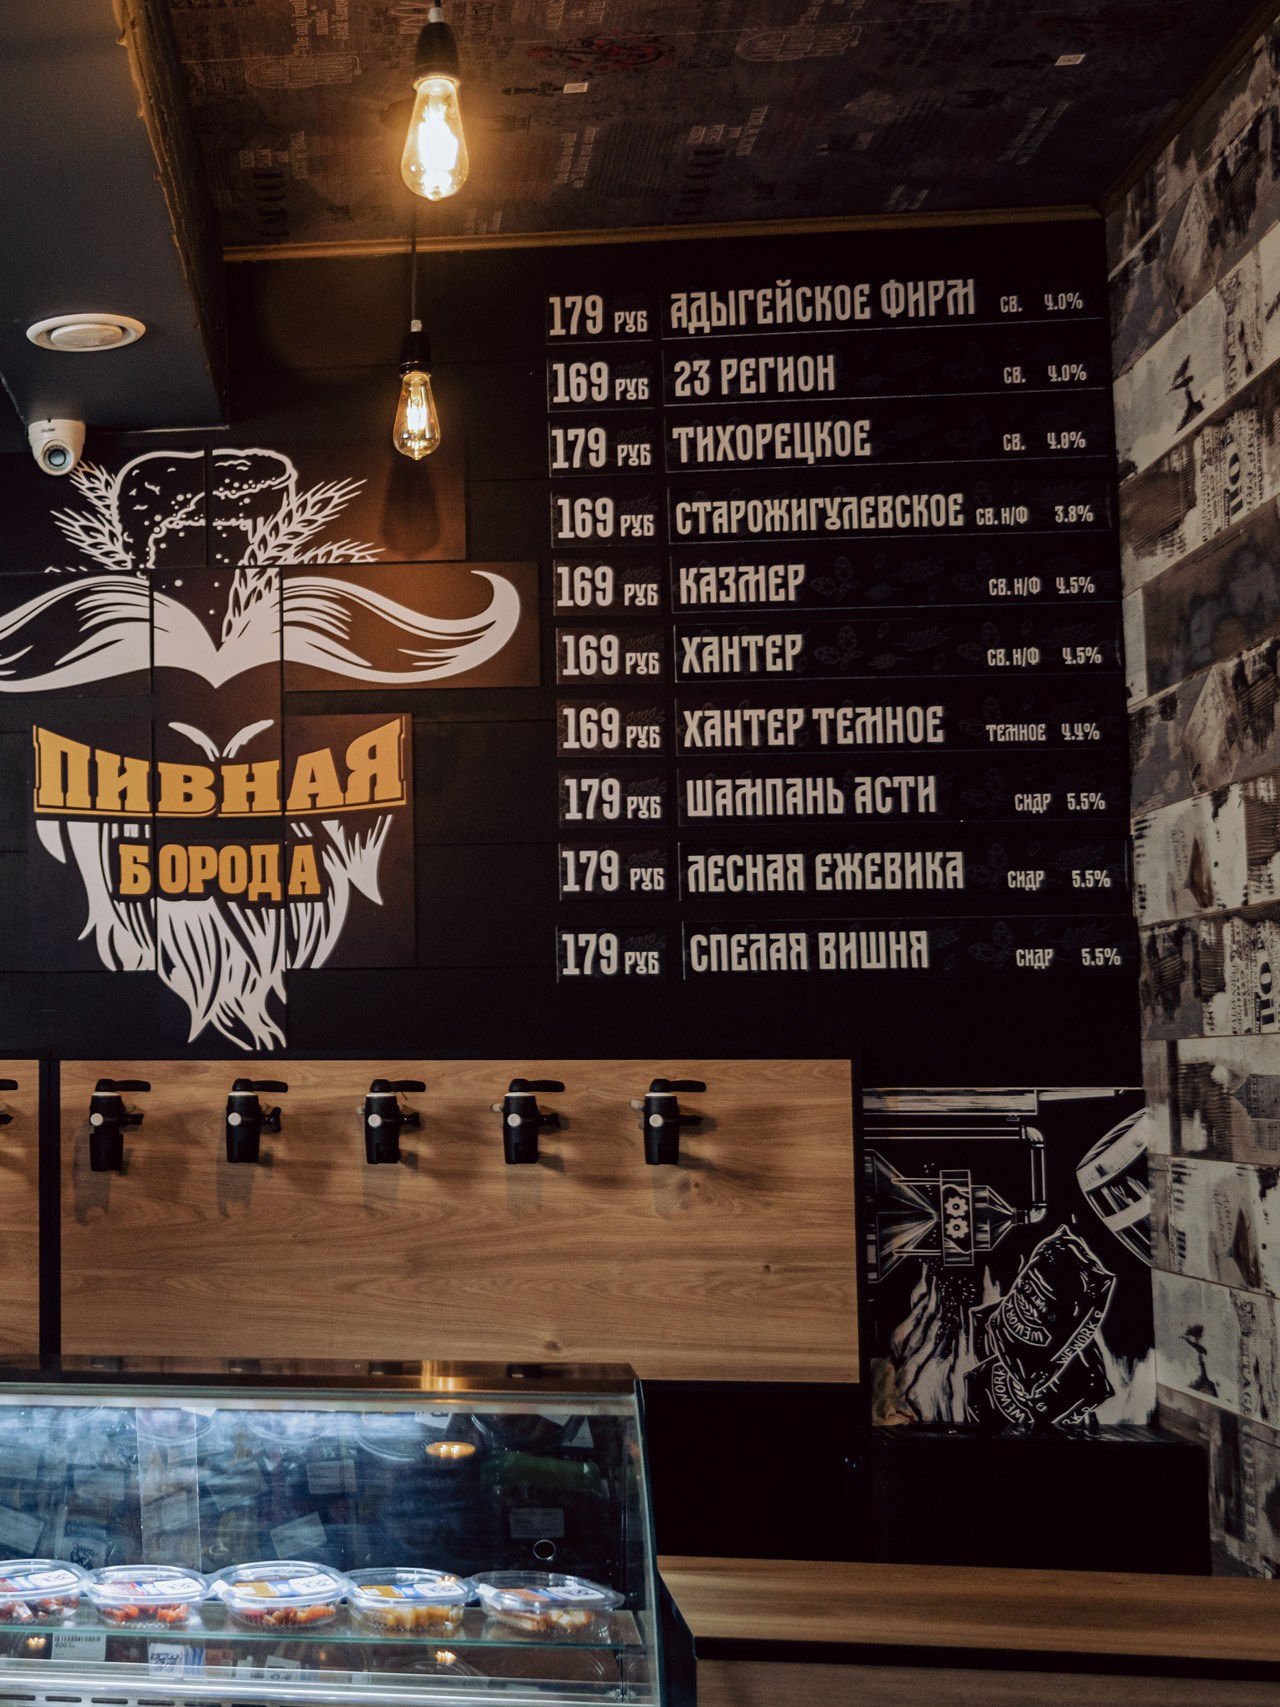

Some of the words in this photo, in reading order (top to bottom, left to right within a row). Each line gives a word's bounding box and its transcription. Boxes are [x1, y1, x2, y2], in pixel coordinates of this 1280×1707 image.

[549, 295, 602, 335] 179
[615, 311, 647, 333] РУБ
[671, 280, 870, 335] АДЫГЕЙСКОЕ
[881, 279, 974, 317] ФИРМ
[1001, 296, 1022, 312] СВ.
[1045, 293, 1082, 310] 4.0%
[553, 362, 608, 402] 169
[616, 378, 648, 400] РУБ
[674, 360, 710, 396] 23
[721, 355, 834, 394] РЕГИОН
[1004, 367, 1025, 383] СВ.
[1048, 364, 1086, 381] 4.0%
[552, 428, 606, 468] 179
[618, 444, 650, 466] РУБ
[673, 420, 870, 464] ТИХОРЕЦКОЕ
[1004, 434, 1025, 450] СВ.
[1228, 452, 1242, 518] Oil
[558, 498, 613, 538] 169
[621, 515, 654, 536] РУБ
[676, 494, 963, 534] СТАРОЖИГУЛЕВСКОЕ
[1055, 505, 1093, 522] 3.8%
[557, 566, 613, 606] 169
[625, 584, 658, 606] РУБ
[680, 565, 804, 604] КАЗМЕР
[1056, 577, 1094, 593] 4.5%
[563, 635, 618, 675] 169
[626, 653, 659, 674] РУБ
[682, 635, 802, 673] ХАНТЕР
[1063, 647, 1101, 664] 4.5%
[563, 708, 619, 748] 169
[627, 726, 660, 748] РУБ
[684, 709, 804, 747] ХАНТЕР
[812, 706, 943, 744] ТЕМНОЕ
[986, 724, 1045, 741] ТЕМНОЕ
[1062, 723, 1099, 740] 4.4%
[34, 718, 406, 817] ПИВНАЯ
[565, 778, 620, 819] 179
[627, 796, 660, 818] РУБ
[687, 778, 844, 816] ШАМПАНЬ
[855, 776, 935, 813] АСТИ
[1015, 794, 1051, 813] СИДР
[1067, 793, 1105, 810] 5.5%
[119, 843, 320, 901] БОРОДА
[562, 850, 618, 891] 179
[630, 868, 664, 890] РУБ
[688, 854, 804, 892] ЛЕСНАЯ
[816, 852, 963, 890] ЕЖЕВИКА
[1008, 871, 1044, 890] СИДР
[1072, 870, 1110, 887] 5.5%
[562, 933, 617, 974] 179
[625, 952, 659, 974] РУБ
[691, 933, 807, 971] СПЕЛАЯ
[818, 931, 928, 969] ВИШНЯ
[1016, 949, 1053, 969] СИДР
[1082, 948, 1121, 965] 5.5%
[1260, 962, 1275, 1025] Oil
[1056, 1321, 1097, 1364] WEWORK
